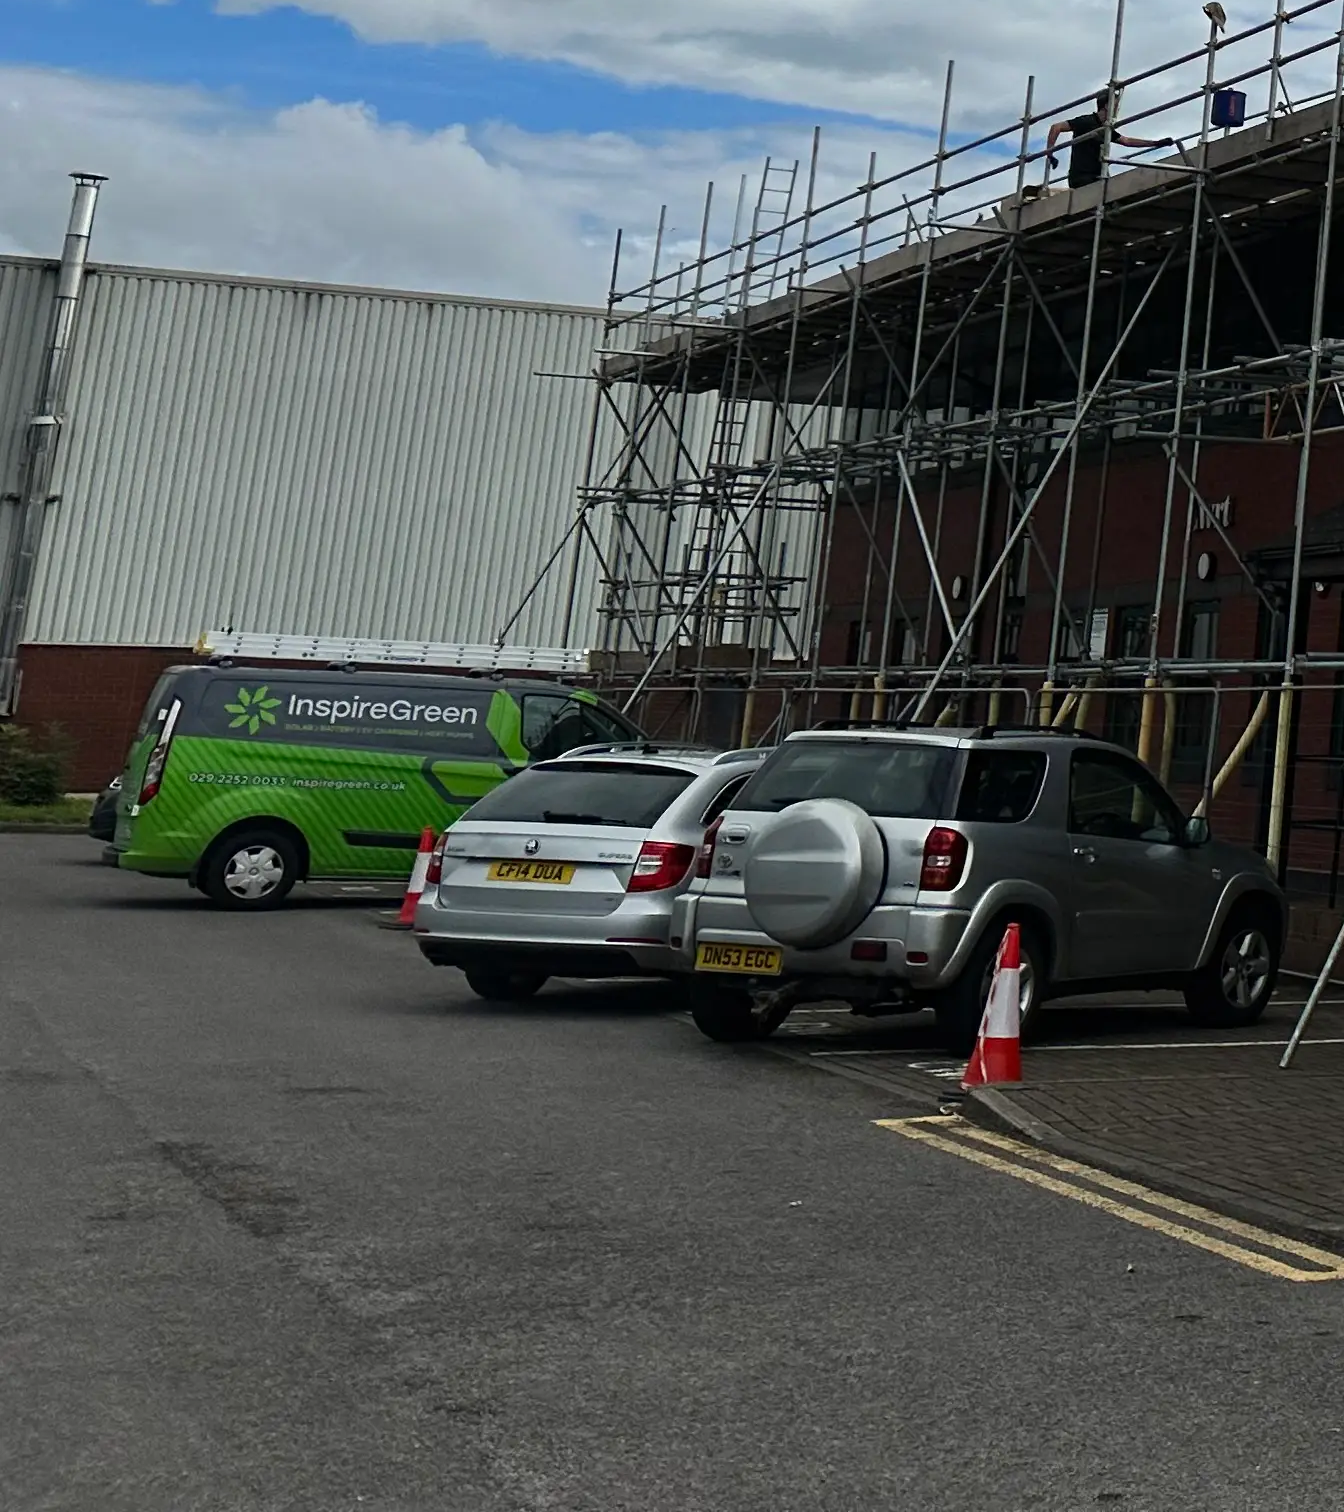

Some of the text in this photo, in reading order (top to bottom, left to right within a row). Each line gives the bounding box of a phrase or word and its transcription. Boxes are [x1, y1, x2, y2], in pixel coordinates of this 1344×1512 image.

[288, 694, 477, 725] InspireGreen
[189, 772, 214, 783] 029
[218, 774, 248, 785] 2252
[252, 776, 285, 787] 0033
[496, 862, 564, 881] CF14 DUA
[703, 946, 776, 969] DN53 EGC
